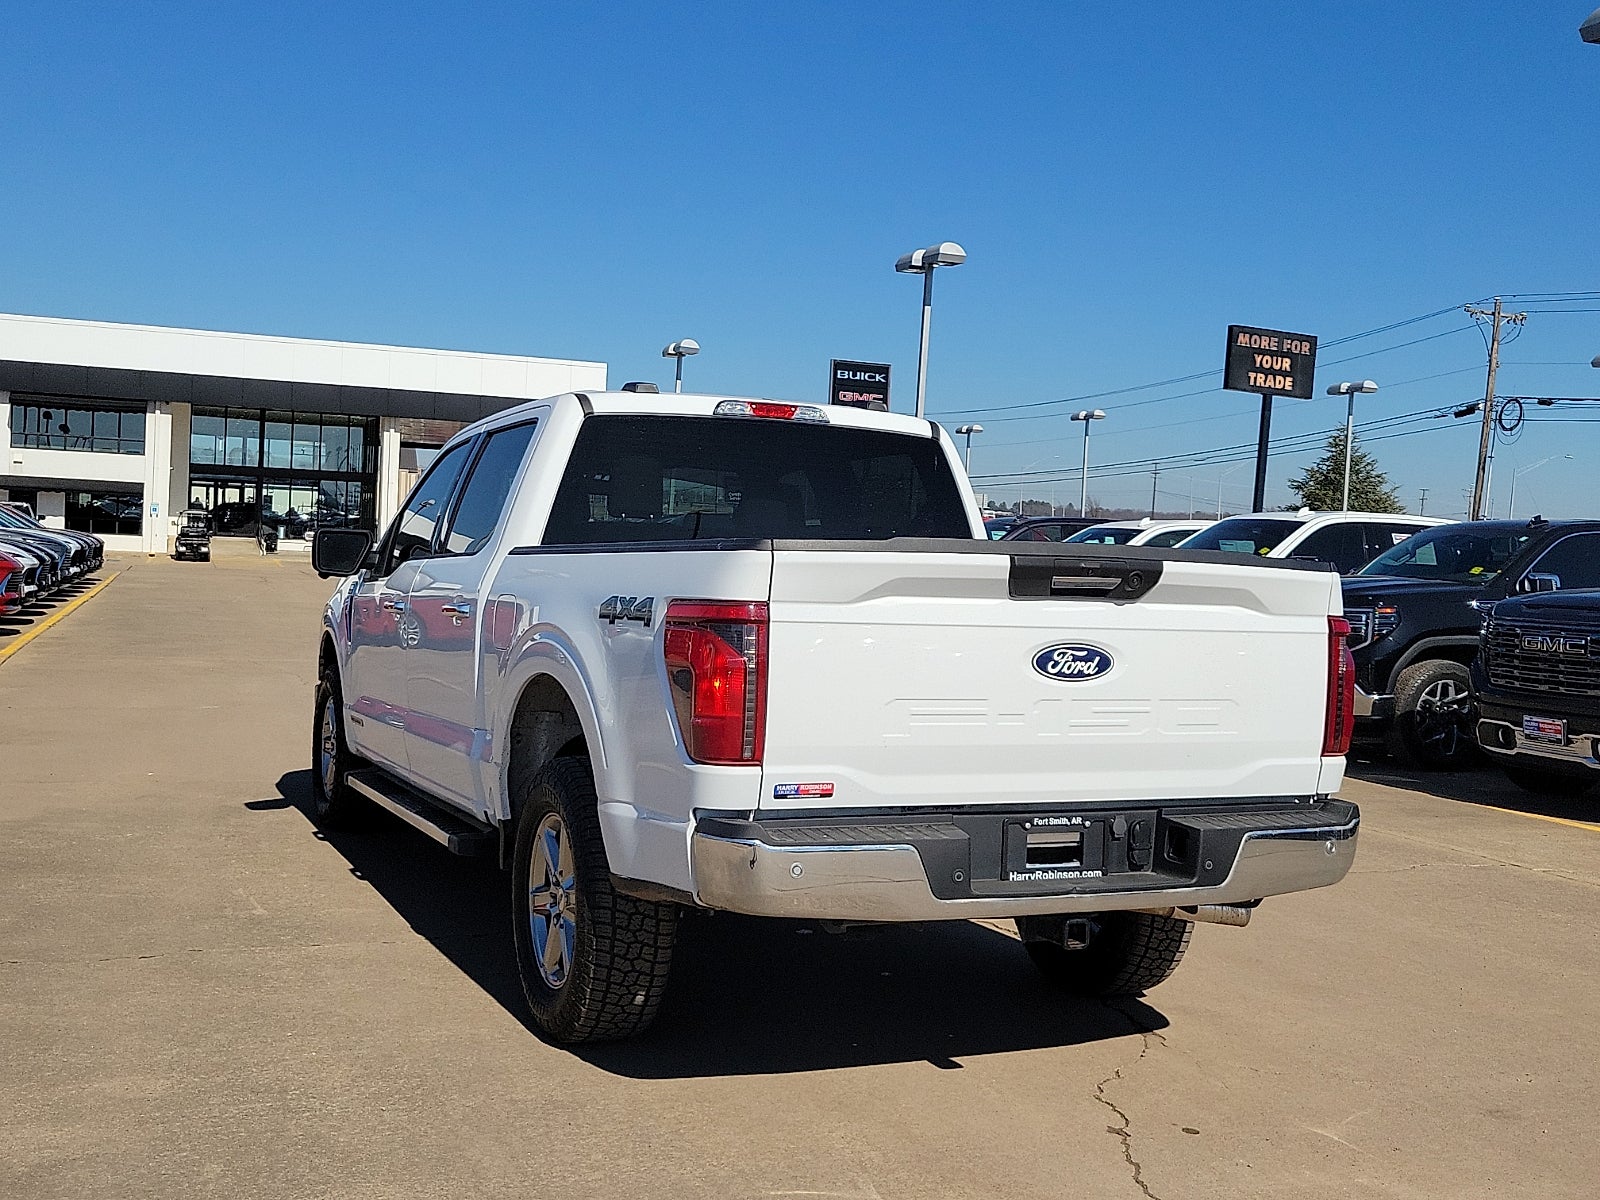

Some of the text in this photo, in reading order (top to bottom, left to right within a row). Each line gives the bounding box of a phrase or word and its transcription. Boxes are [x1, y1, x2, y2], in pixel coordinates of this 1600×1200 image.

[1237, 333, 1311, 356] MORE FOR
[1254, 353, 1292, 372] YOUR
[837, 370, 886, 382] BUICK
[1248, 371, 1294, 391] TRADE
[839, 391, 883, 403] GMC
[1521, 635, 1585, 654] GMC
[1047, 648, 1101, 675] Ford
[1033, 817, 1083, 826] Fort Smith, AR
[1009, 870, 1102, 881] HarryRobinson.com
